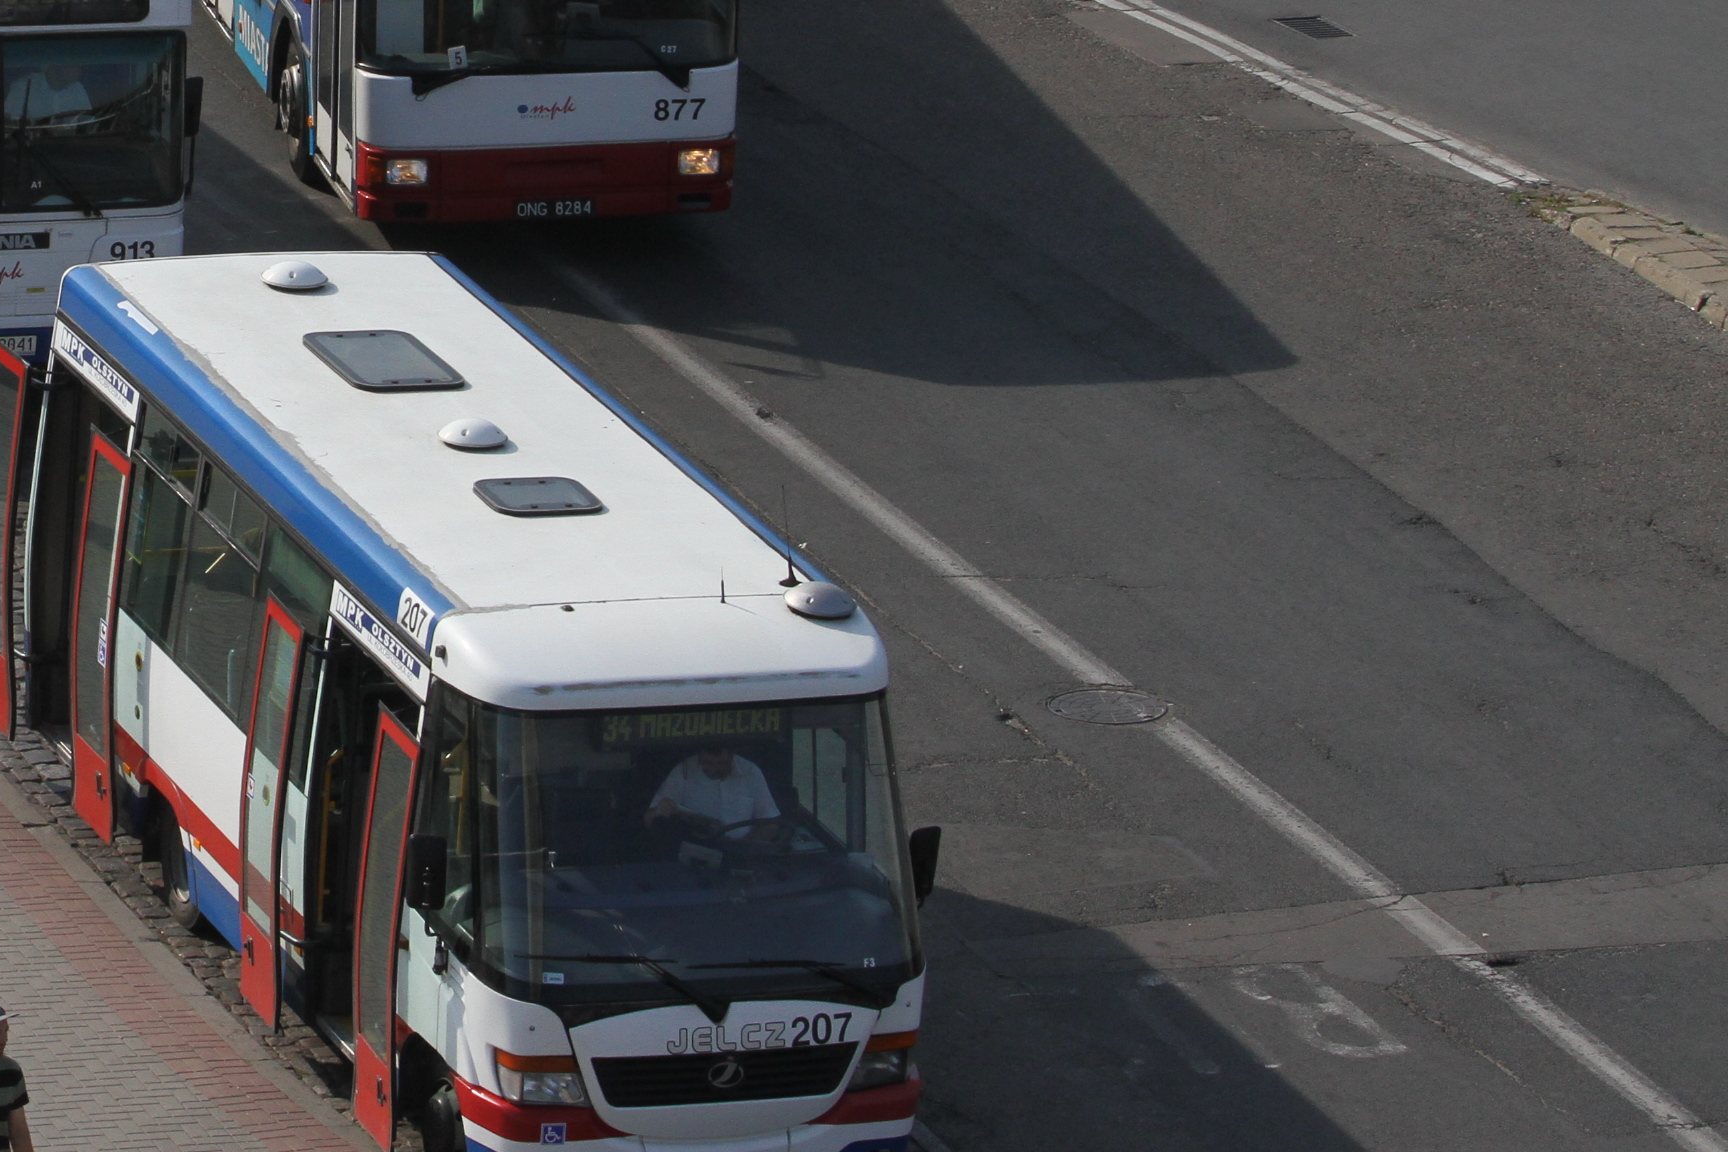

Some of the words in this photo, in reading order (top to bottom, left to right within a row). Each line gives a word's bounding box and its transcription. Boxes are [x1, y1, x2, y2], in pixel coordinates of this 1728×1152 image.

[455, 51, 462, 65] 5
[530, 96, 576, 121] mpk
[654, 98, 707, 121] 877
[30, 180, 42, 189] A1
[517, 202, 548, 217] ONG
[555, 200, 592, 216] 8284
[110, 240, 155, 260] 913
[62, 329, 85, 364] MPK
[92, 356, 128, 397] OLSZTYN
[401, 597, 427, 638] 207
[336, 590, 364, 630] MPK
[371, 623, 414, 671] OLSZTYN
[603, 714, 631, 742] 34
[639, 709, 780, 737] MAZOWIECKA
[864, 957, 876, 968] F3
[667, 1021, 787, 1055] JELCZ
[791, 1012, 853, 1048] 207
